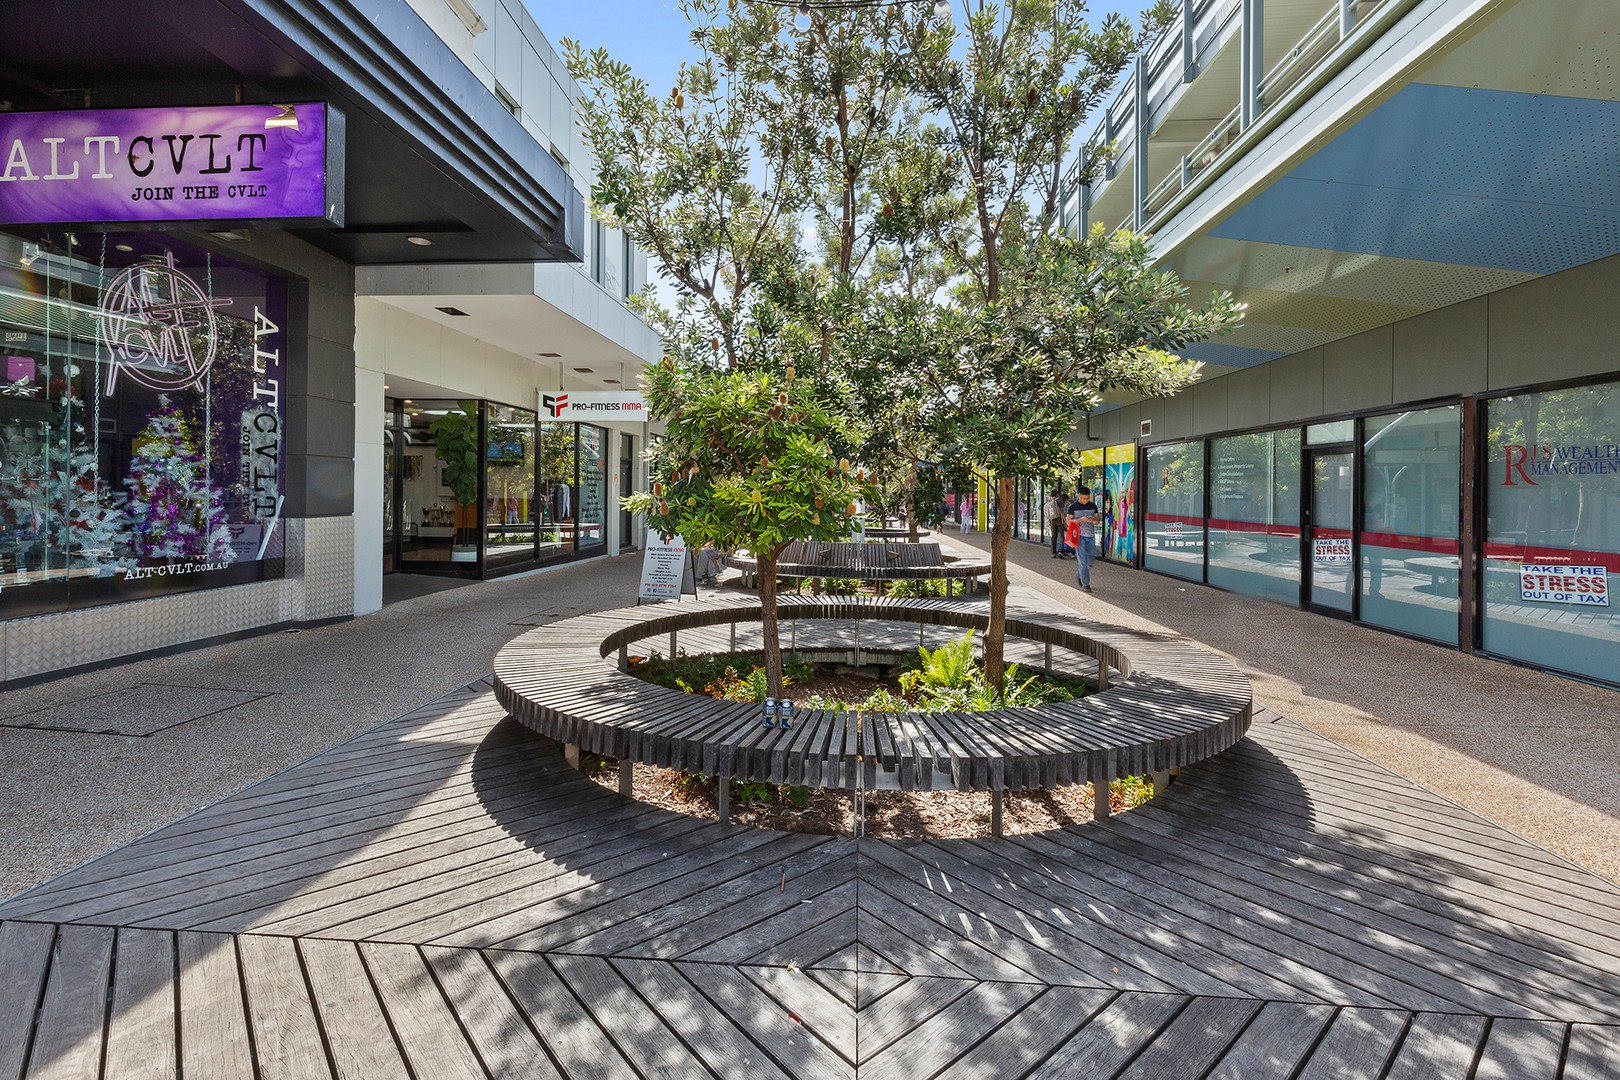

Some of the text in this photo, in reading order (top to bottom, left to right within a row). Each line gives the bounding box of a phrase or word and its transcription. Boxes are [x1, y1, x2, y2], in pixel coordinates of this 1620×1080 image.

[131, 185, 267, 201] JOIN THE CVLT
[572, 402, 642, 411] PRO-FITNESS MMA
[242, 426, 251, 457] JOIN
[1316, 545, 1350, 555] STRESS
[124, 561, 229, 580] ALT-CVLT.COM.AU
[1522, 565, 1604, 575] TAKE THE
[1523, 574, 1605, 594] STRESS
[1523, 591, 1549, 599] OUT
[1577, 594, 1606, 604] TAX
